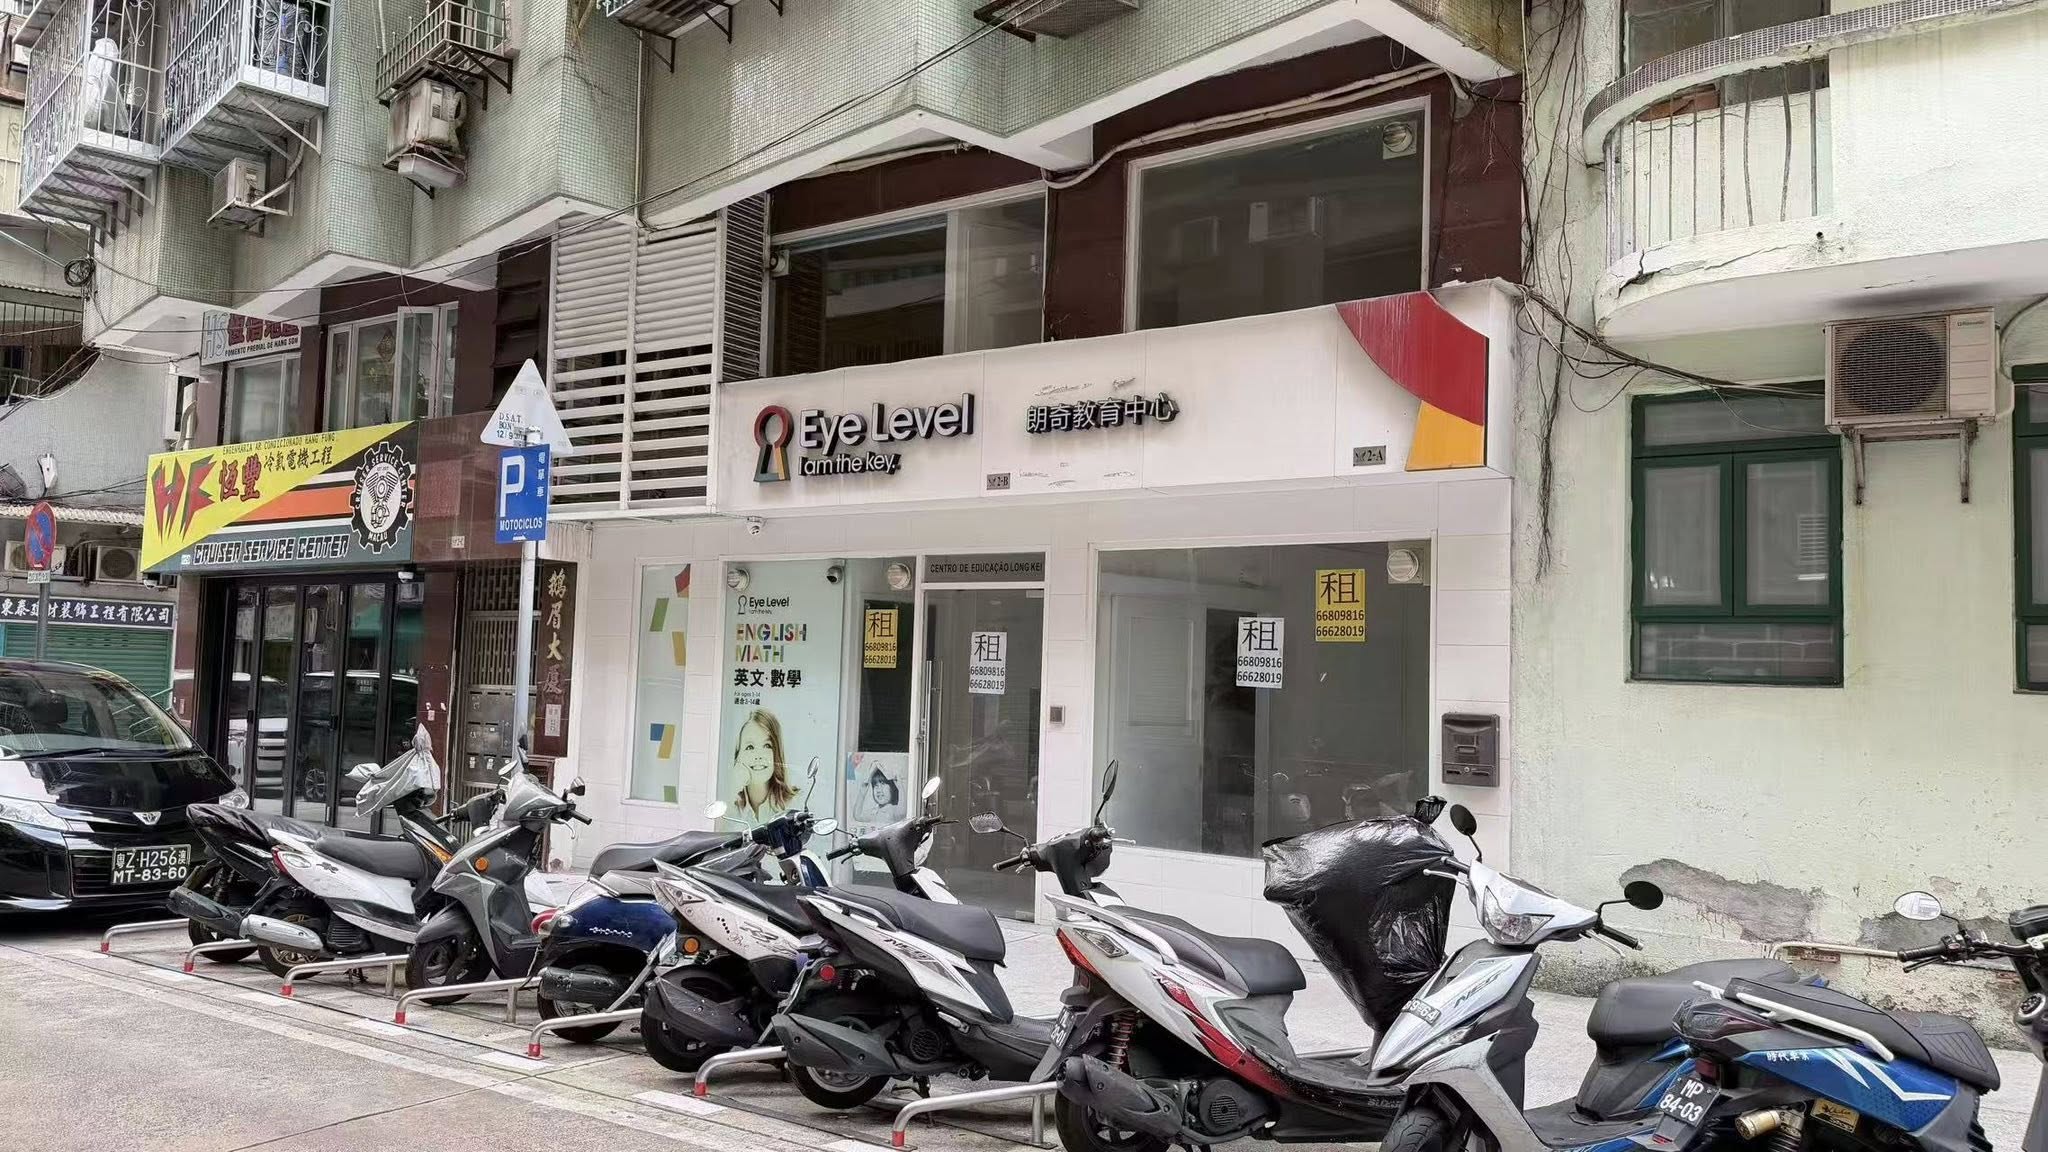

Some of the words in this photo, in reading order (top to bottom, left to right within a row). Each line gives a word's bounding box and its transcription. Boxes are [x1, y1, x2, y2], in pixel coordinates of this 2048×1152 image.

[1026, 392, 1179, 433] 朗奇教育中心
[800, 408, 867, 456] Eye
[871, 393, 974, 442] Level
[264, 446, 333, 472] 冷氣電機工程
[804, 456, 833, 475] am
[836, 453, 864, 474] the
[371, 453, 399, 469] SERVICE
[398, 466, 408, 508] CENTER
[500, 454, 525, 518] P
[500, 517, 543, 531] MOTOCICLOS
[367, 531, 388, 542] MACAU
[242, 536, 295, 563] SERVICE
[296, 533, 350, 560] CENTER
[930, 563, 957, 573] CENTRO
[959, 563, 969, 573] DE
[971, 561, 1010, 575] EDUCAÇÃO
[1010, 562, 1030, 573] LONG
[1031, 562, 1043, 572] KEI
[1320, 572, 1360, 605] 租
[749, 597, 765, 609] Eye
[766, 596, 790, 608] Level
[868, 611, 894, 638] 租
[1316, 609, 1365, 622] 66809816
[736, 623, 807, 641] ENGLISH
[1242, 620, 1278, 652] 租
[1316, 625, 1364, 637] 66628019
[735, 644, 784, 663] MATH
[864, 641, 897, 651] 66809816
[974, 634, 1002, 662] 租
[864, 655, 896, 665] 66628019
[1237, 656, 1282, 668] 66809816
[970, 666, 1005, 677] 66809816
[1237, 671, 1282, 683] 66628019
[969, 679, 1004, 690] 66628019
[112, 866, 187, 883] MT-83-60
[1680, 1079, 1704, 1099] MP
[1659, 1094, 1704, 1122] 84-03
